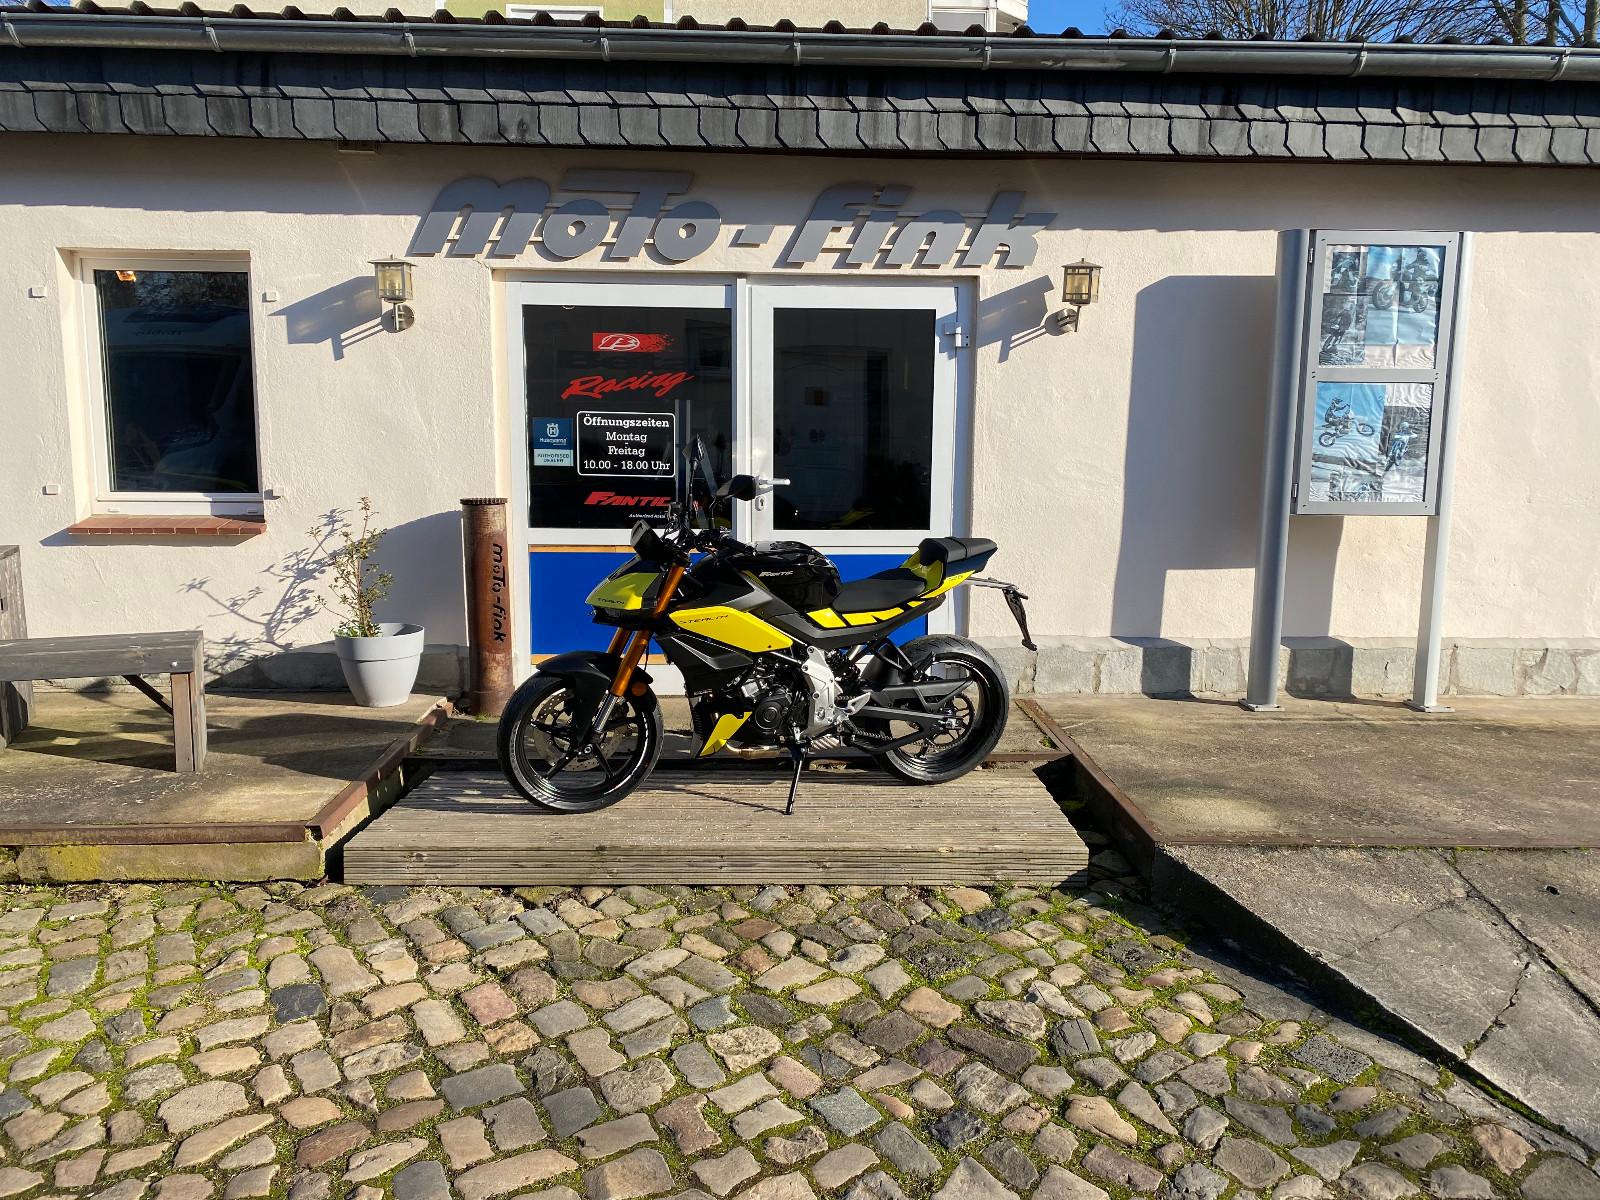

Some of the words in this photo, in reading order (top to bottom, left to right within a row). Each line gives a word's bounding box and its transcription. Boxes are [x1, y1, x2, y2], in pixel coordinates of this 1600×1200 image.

[561, 371, 695, 399] Racing
[583, 414, 670, 429] Öffnungszeiten
[605, 431, 648, 443] Montag
[607, 445, 646, 457] Freitag
[583, 459, 611, 470] 10.00
[621, 460, 649, 470] 18.00
[650, 460, 671, 470] Uhr
[583, 491, 672, 507] FANTIC
